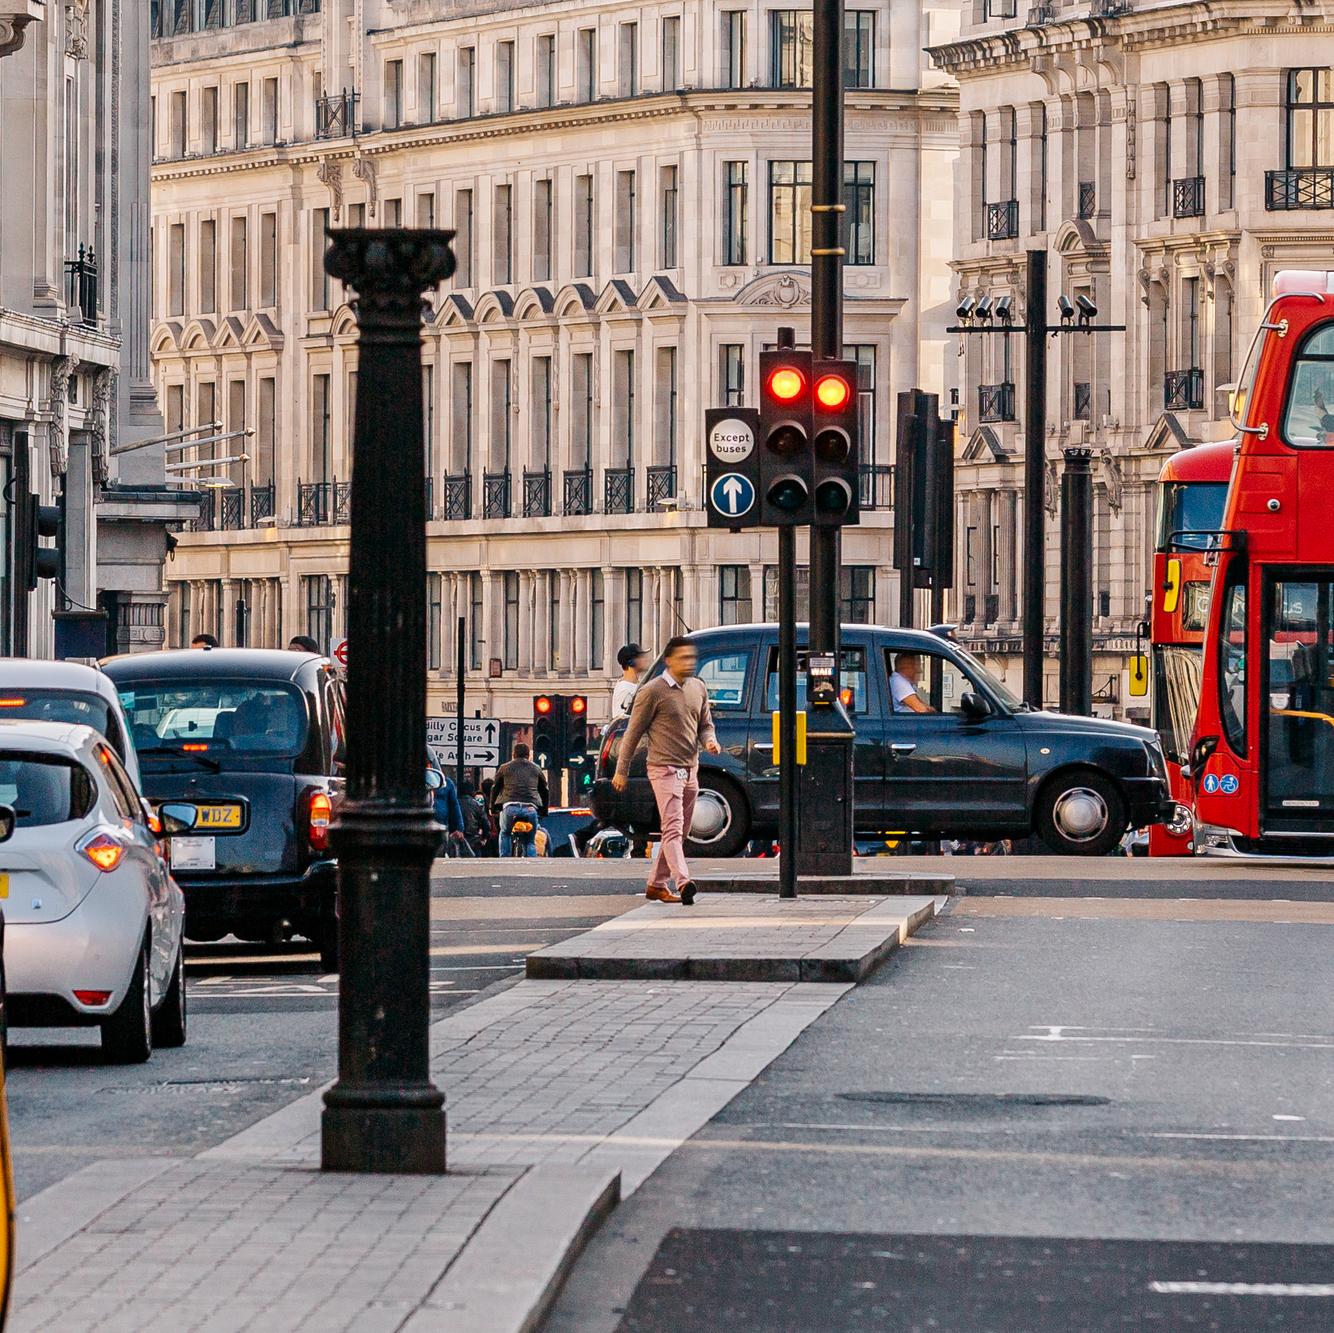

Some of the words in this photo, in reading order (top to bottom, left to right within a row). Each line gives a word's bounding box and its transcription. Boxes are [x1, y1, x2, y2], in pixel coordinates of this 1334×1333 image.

[714, 433, 749, 444] Except
[717, 444, 747, 453] buses
[811, 668, 832, 676] WAIT
